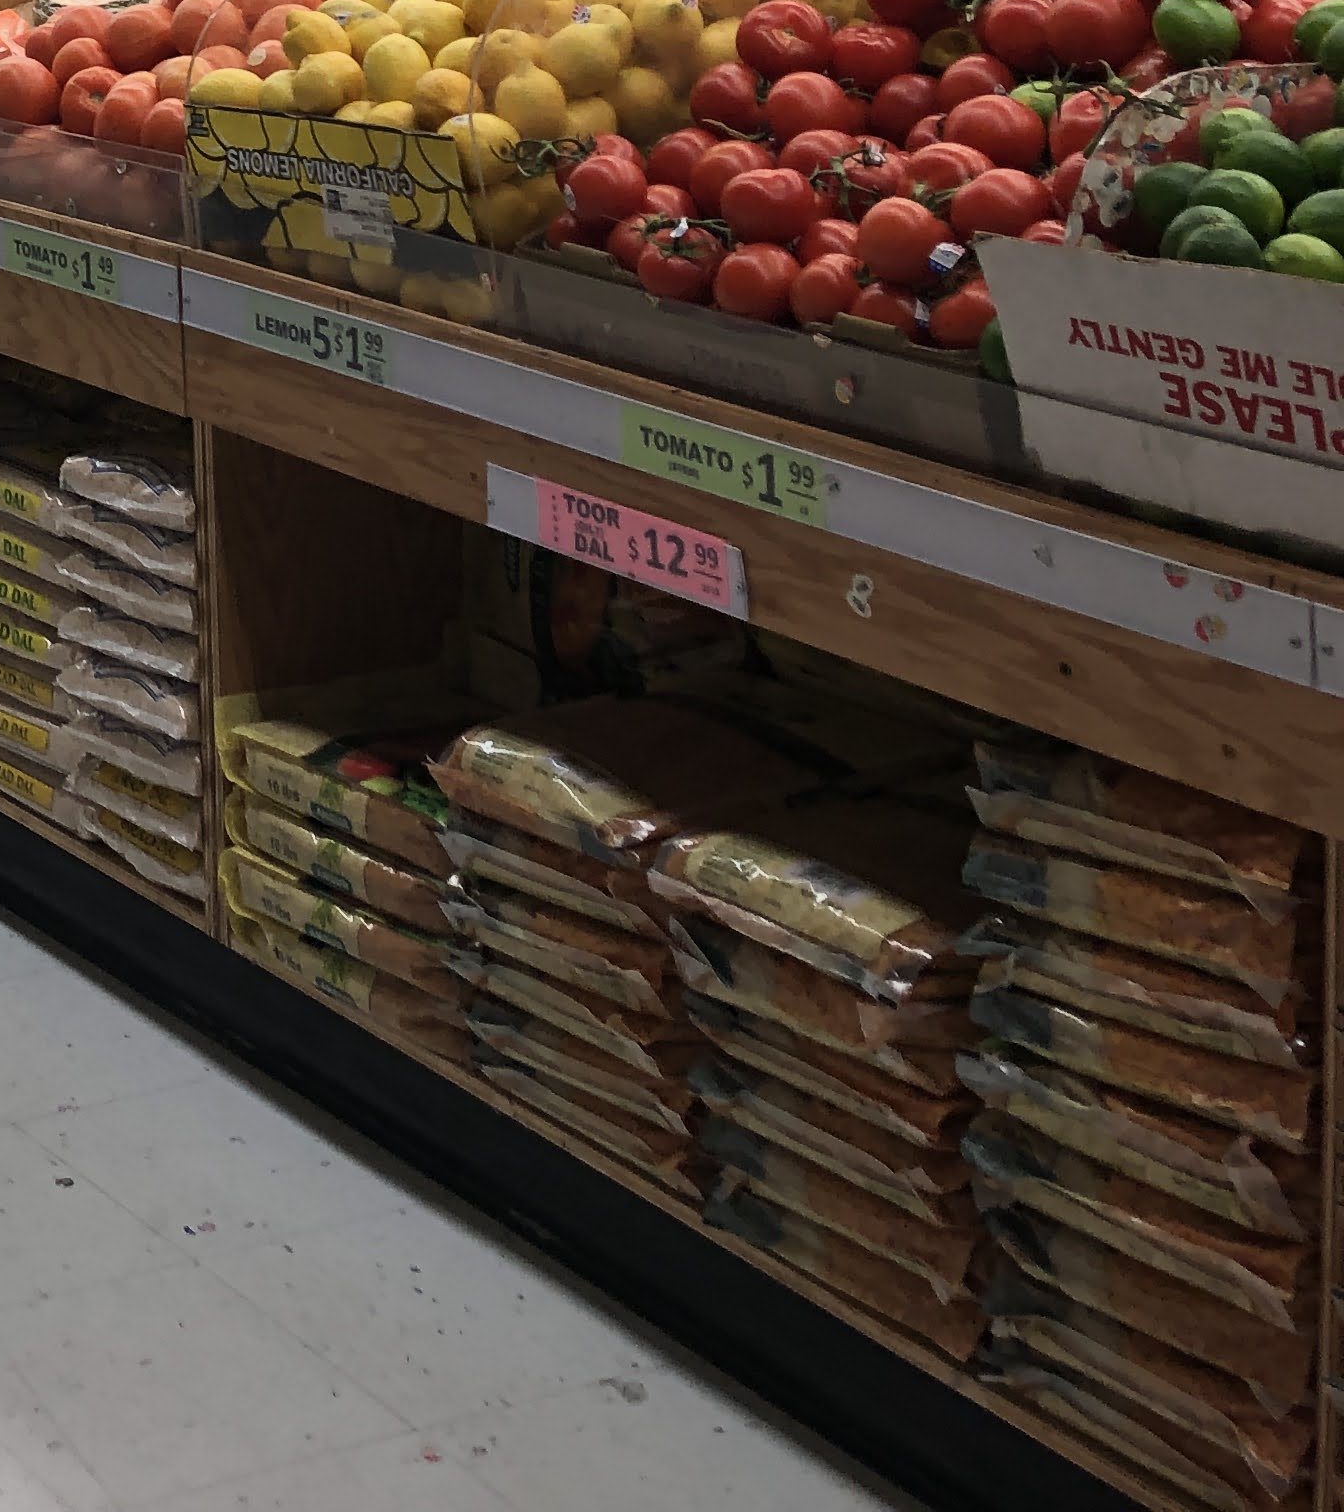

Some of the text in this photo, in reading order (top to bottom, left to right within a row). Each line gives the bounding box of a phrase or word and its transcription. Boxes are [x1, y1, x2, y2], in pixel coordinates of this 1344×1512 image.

[227, 147, 415, 197] CALIFORNIA LEMONS
[13, 239, 67, 268] TOMATO
[255, 312, 311, 346] LEMON
[1069, 317, 1344, 401] LE ME GENTLY
[639, 425, 734, 472] TOMATO
[563, 493, 620, 529] TOOR
[575, 533, 614, 562] DAL
[12, 588, 37, 612] DAL
[12, 628, 35, 653] DAL
